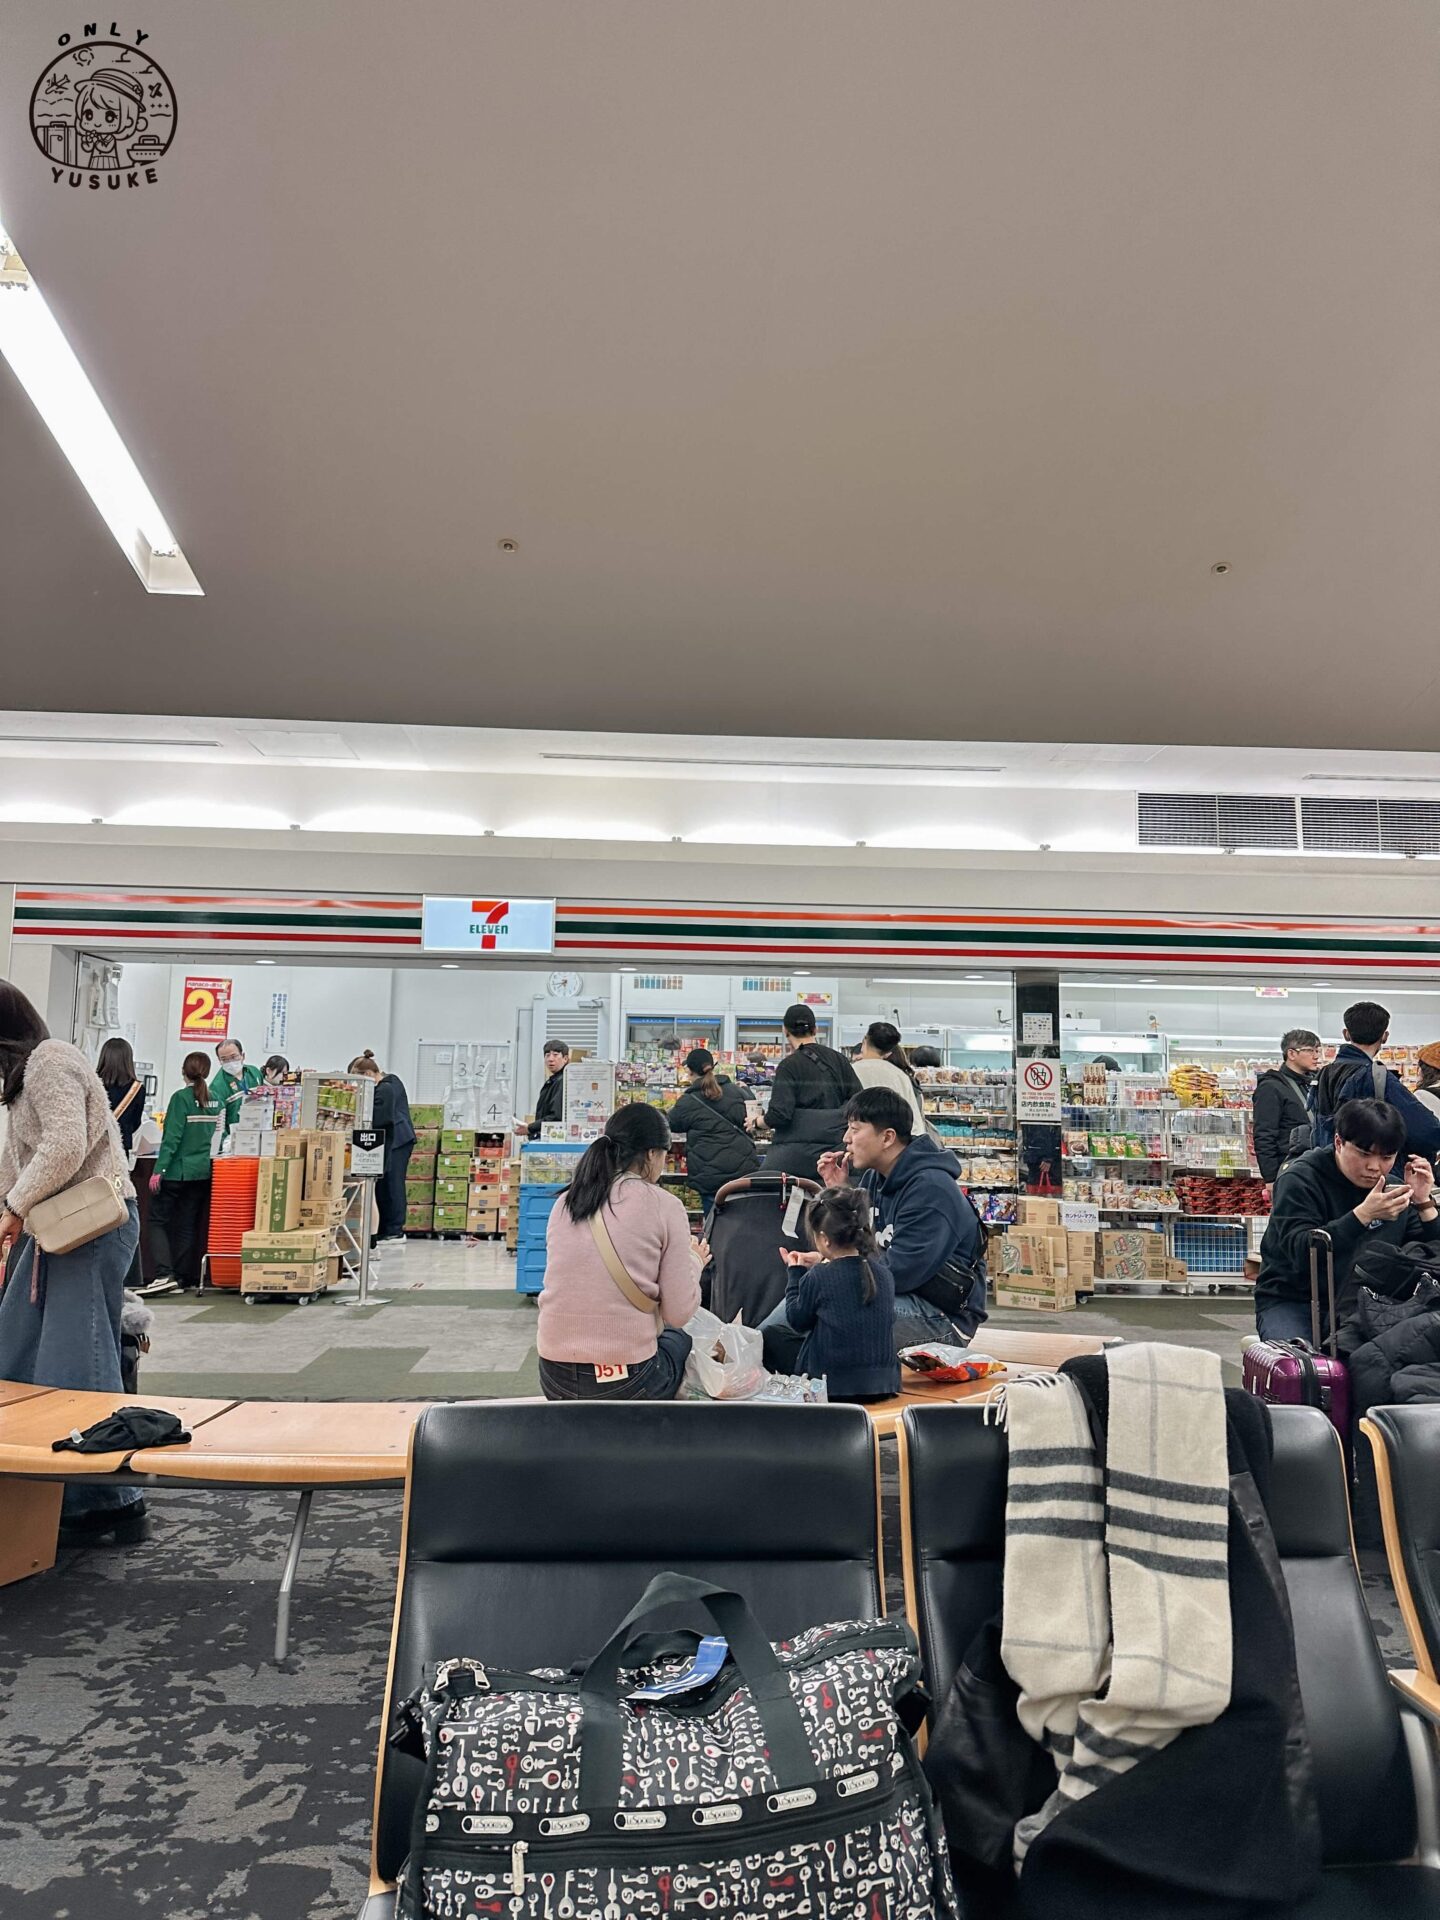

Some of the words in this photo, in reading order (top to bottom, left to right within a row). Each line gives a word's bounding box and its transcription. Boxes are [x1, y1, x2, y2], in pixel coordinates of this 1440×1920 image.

[183, 989, 215, 1028] 2
[458, 1062, 467, 1076] 3
[475, 1064, 485, 1077] 2
[501, 1063, 506, 1072] 1
[451, 1112, 464, 1126] 5
[487, 1104, 502, 1120] 4
[360, 1132, 376, 1141] 出口
